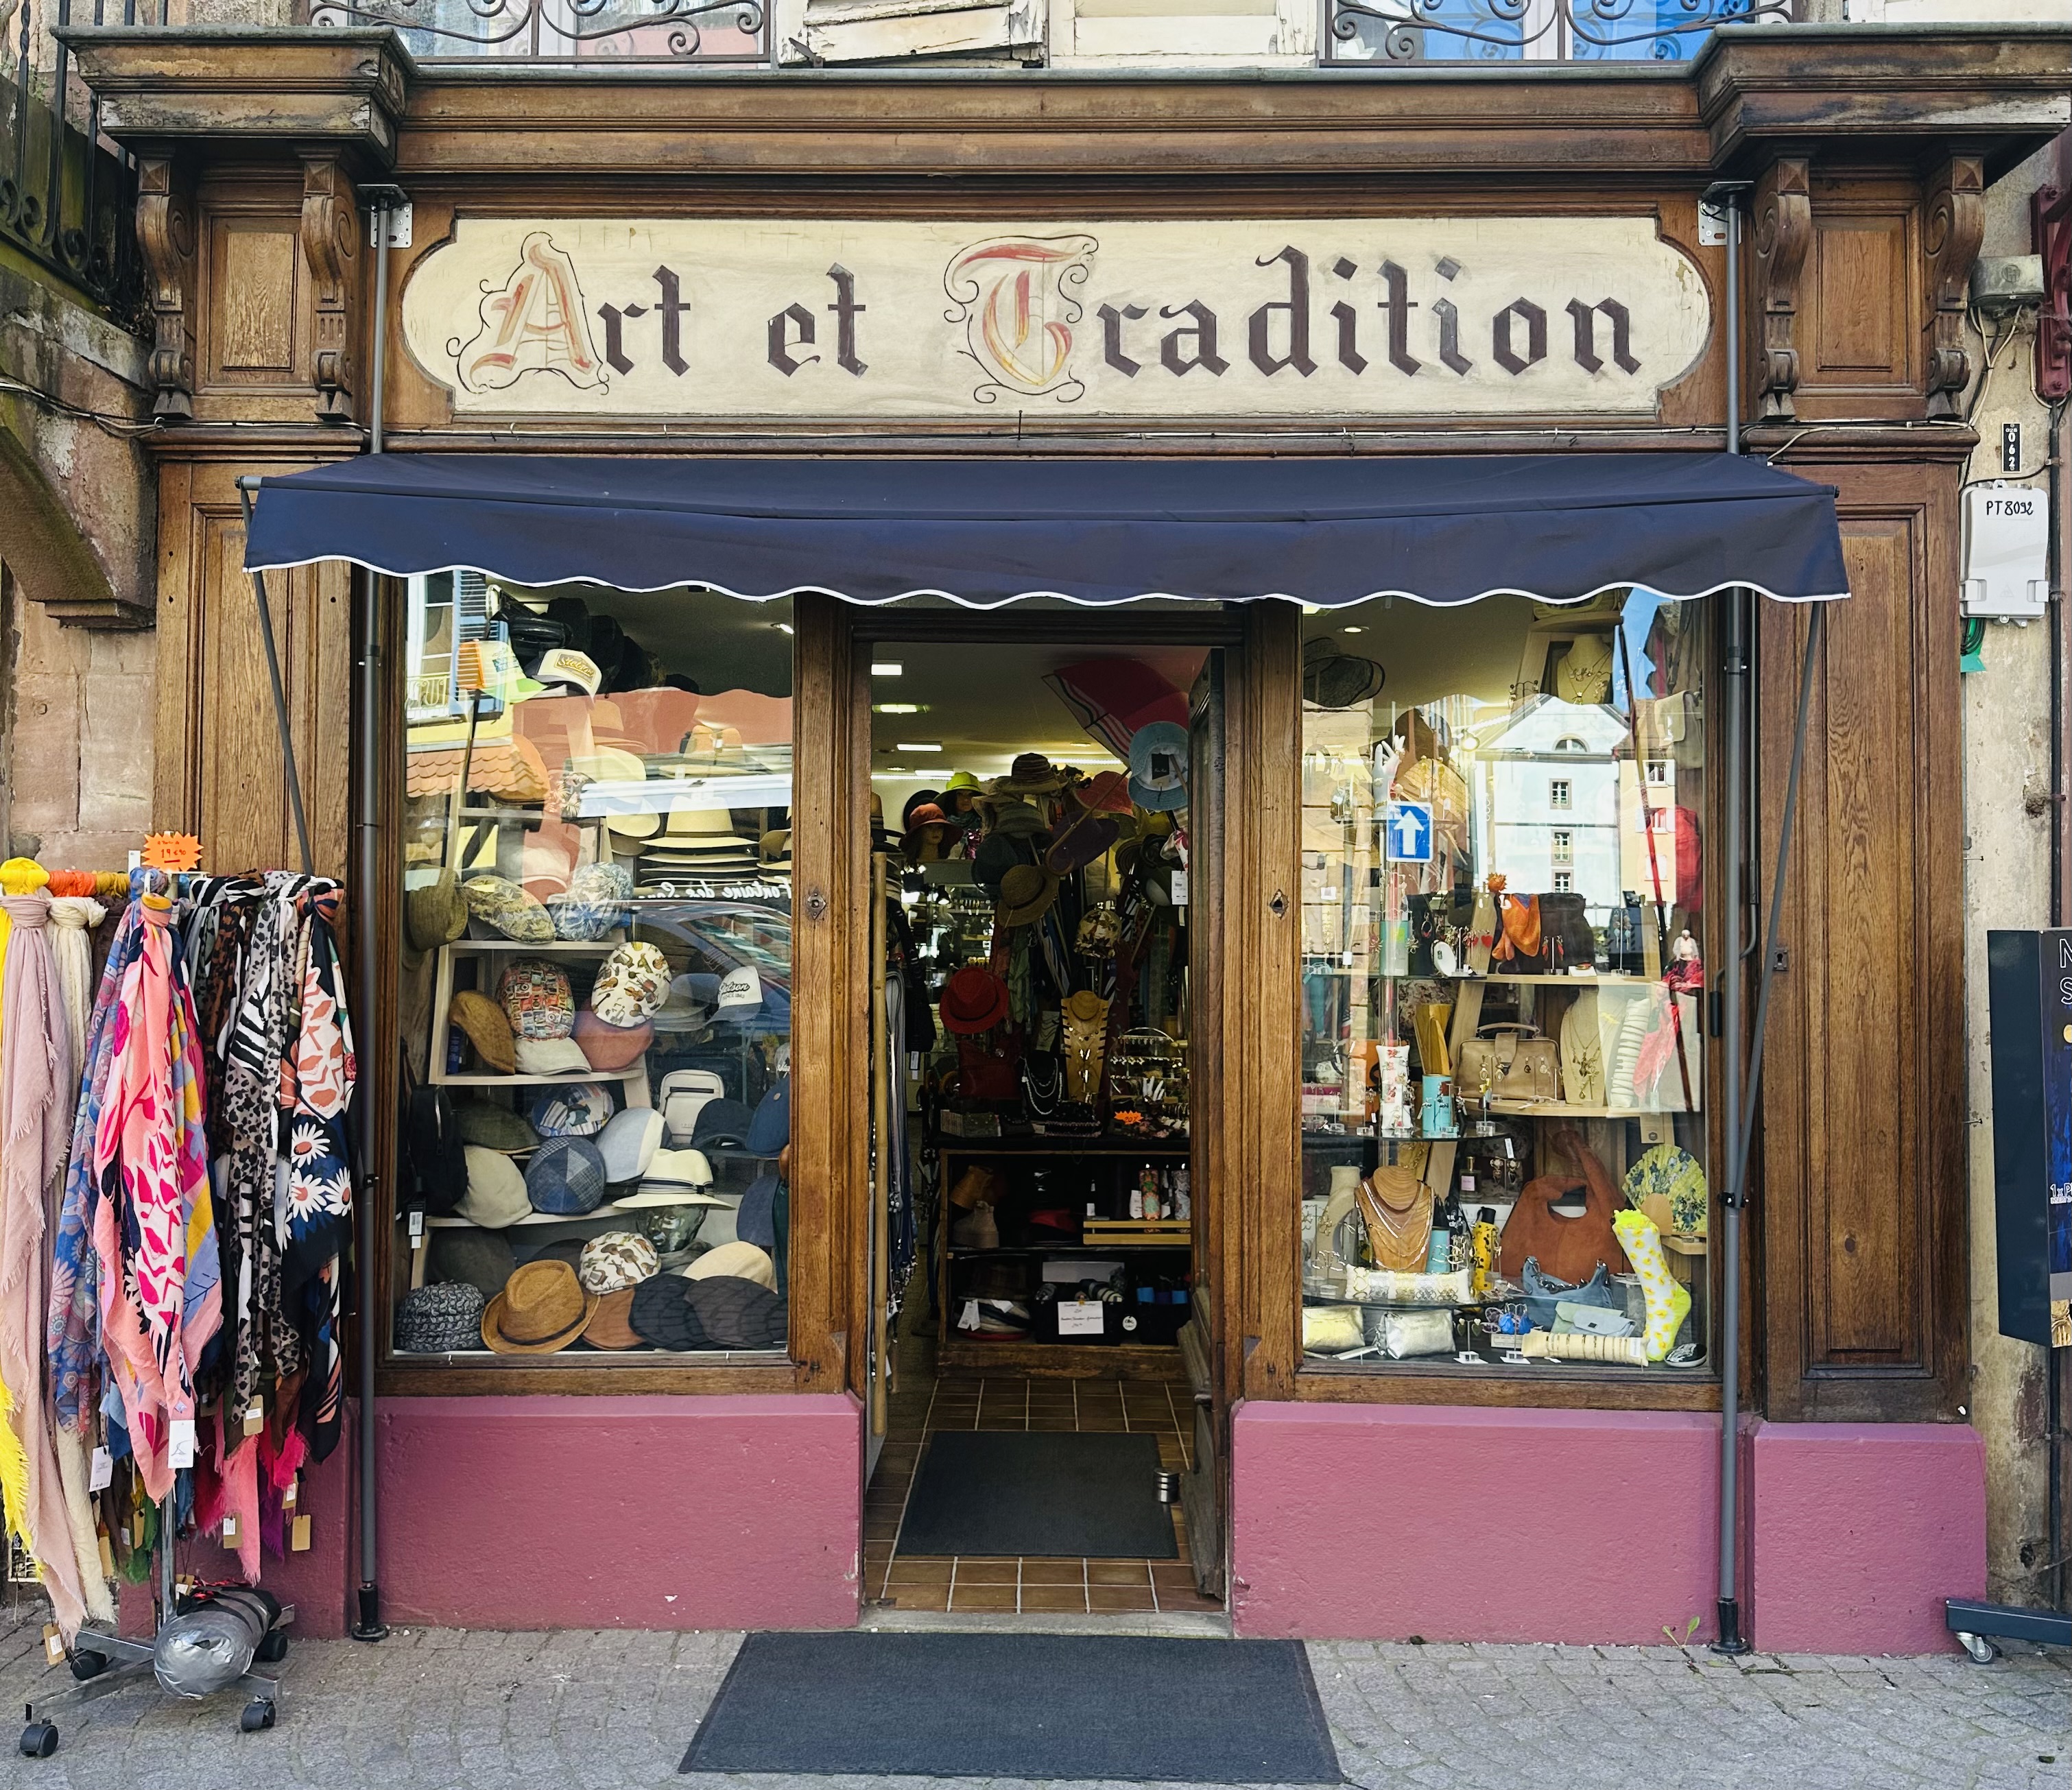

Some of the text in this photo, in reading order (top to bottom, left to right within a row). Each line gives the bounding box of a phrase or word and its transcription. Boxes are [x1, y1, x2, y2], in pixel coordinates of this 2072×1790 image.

[446, 232, 1641, 403] Art et Tradition
[2008, 432, 2016, 467] 062
